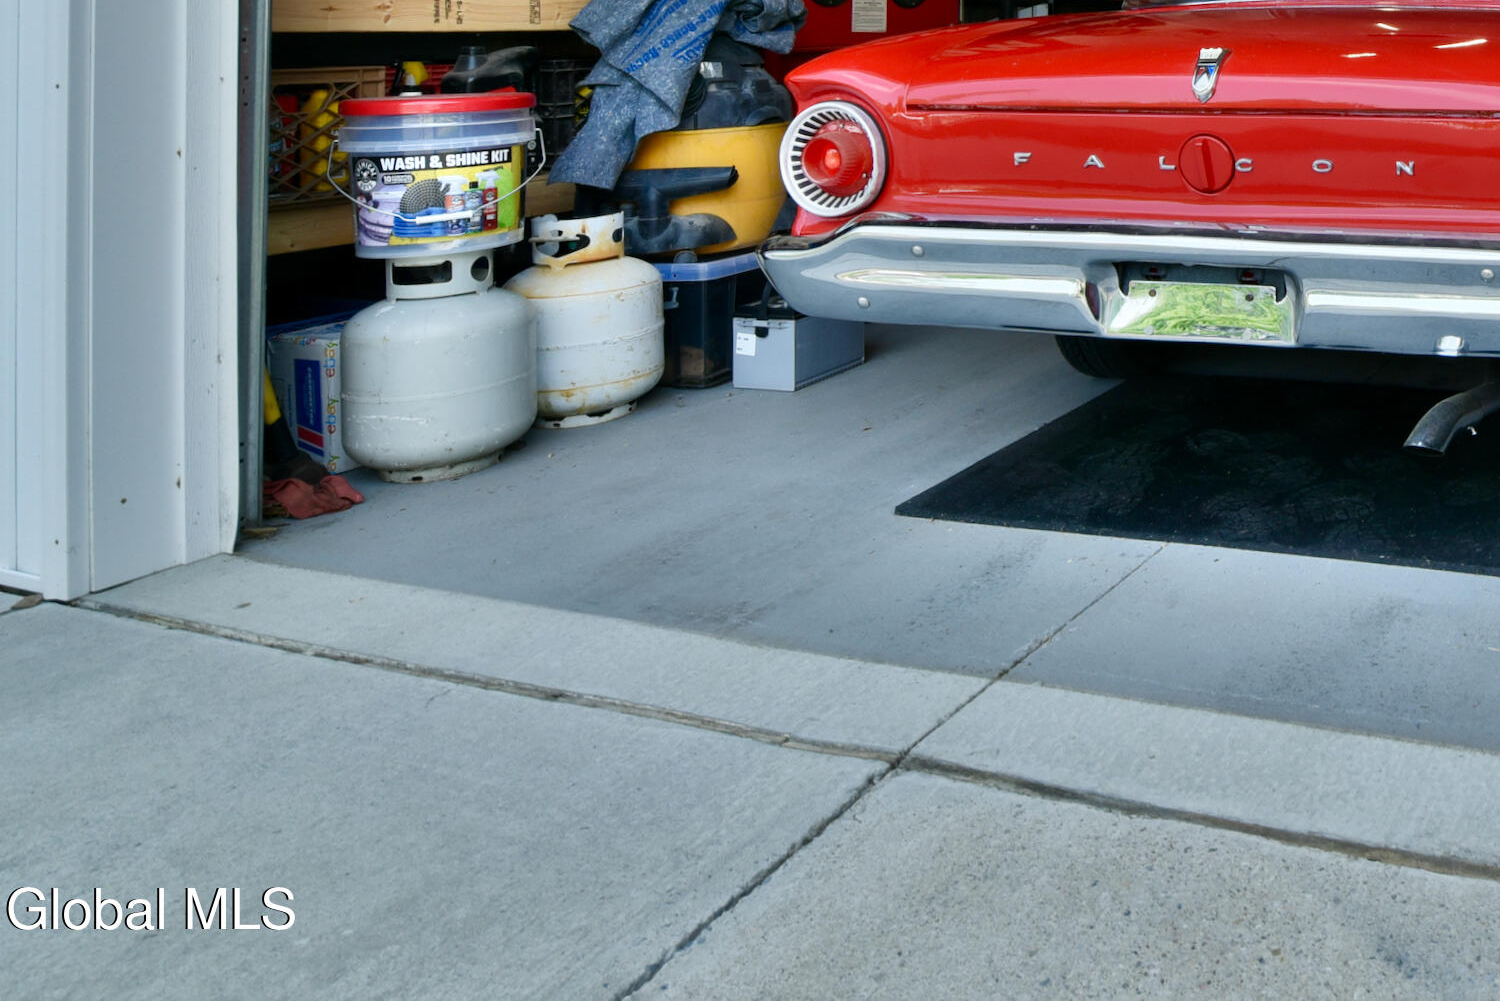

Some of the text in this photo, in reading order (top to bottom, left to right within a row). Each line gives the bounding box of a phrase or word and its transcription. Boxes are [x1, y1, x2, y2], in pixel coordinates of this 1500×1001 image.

[380, 149, 510, 171] WASH & SHINE KIT
[1013, 152, 1415, 176] FALCON
[324, 342, 338, 378] ebay
[325, 398, 340, 435] ebay
